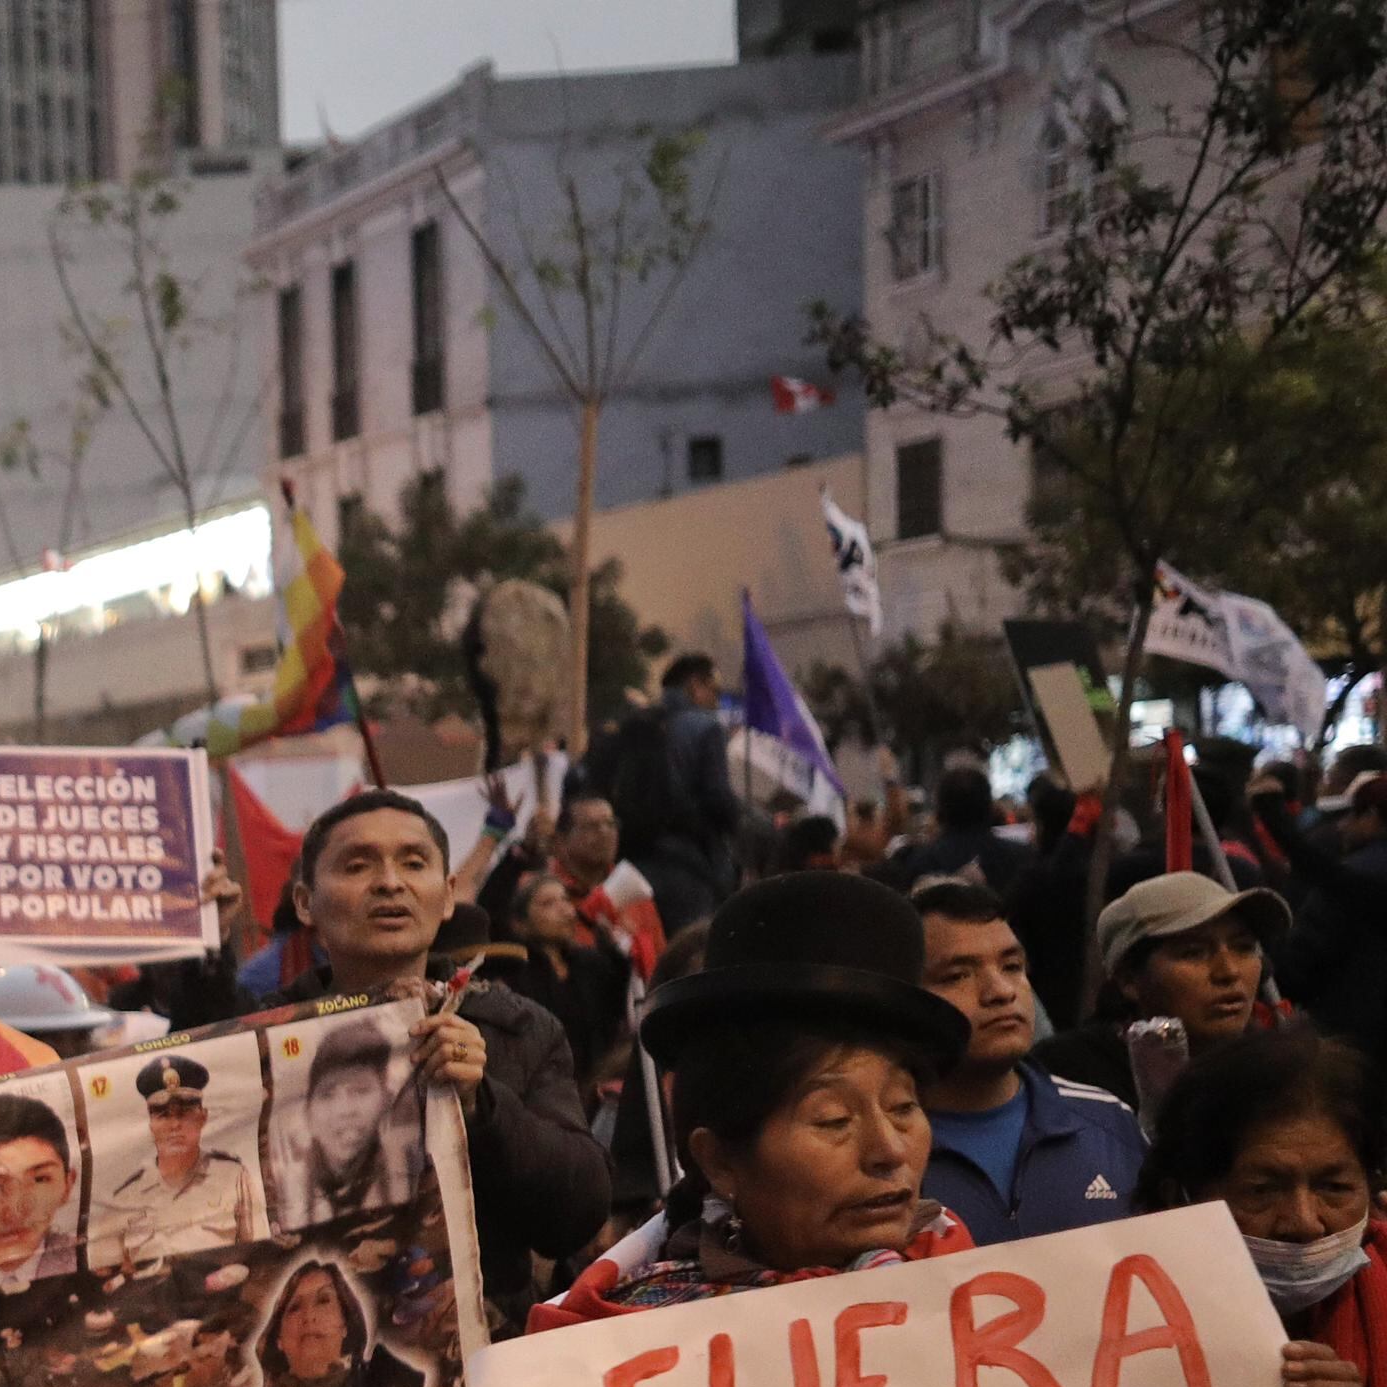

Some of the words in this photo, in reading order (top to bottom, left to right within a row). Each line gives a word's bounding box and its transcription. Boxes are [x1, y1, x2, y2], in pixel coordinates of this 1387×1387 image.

[41, 805, 160, 831] JUECES
[19, 834, 166, 861] FISCALES
[70, 864, 164, 891] VOTO
[0, 893, 163, 921] POPULAR!
[283, 1037, 300, 1057] 18
[91, 1076, 108, 1097] 17
